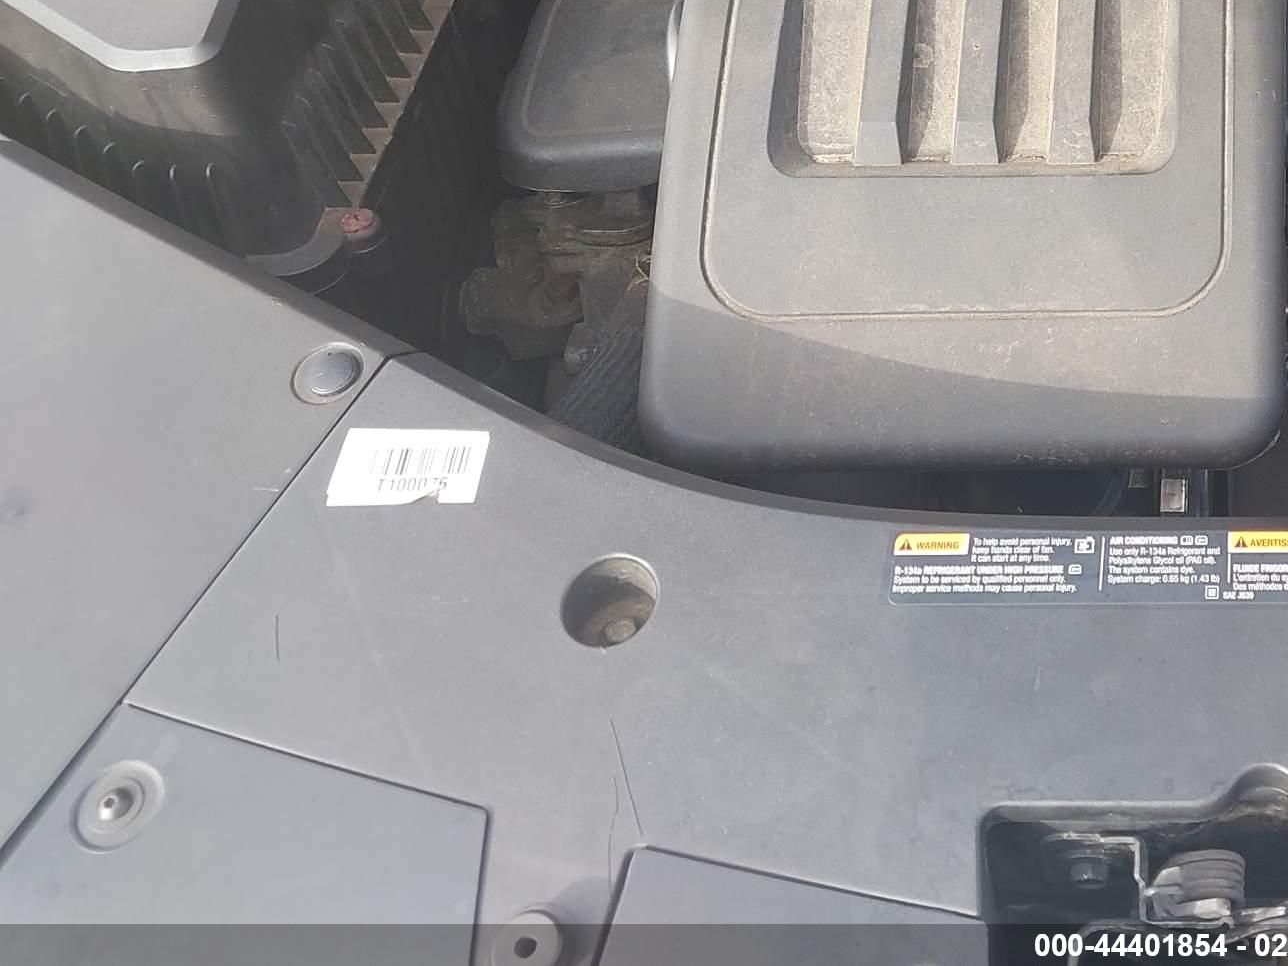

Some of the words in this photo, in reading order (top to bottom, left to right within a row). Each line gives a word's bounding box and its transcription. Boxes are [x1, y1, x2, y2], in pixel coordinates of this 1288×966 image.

[916, 541, 959, 549] WARNING
[974, 538, 981, 546] To
[983, 538, 998, 547] help
[999, 538, 1018, 546] avoid
[1020, 538, 1049, 547] personal
[1051, 538, 1072, 547] injury.
[1110, 547, 1122, 555] Use
[1124, 547, 1139, 556] only
[1140, 547, 1166, 555] R-134a
[1168, 547, 1205, 556] Refrigerant
[1207, 547, 1220, 555] and
[894, 575, 920, 585] System
[930, 575, 940, 583] be
[941, 575, 970, 583] serviced
[972, 575, 981, 585] by
[982, 575, 1012, 585] qualified
[1014, 575, 1048, 585] personnel
[1049, 575, 1065, 584] only.
[1108, 575, 1133, 584] System
[1180, 575, 1189, 584] kg
[893, 585, 924, 594] Improper
[926, 585, 951, 593] service
[985, 586, 1000, 594] may
[1024, 585, 1054, 594] personal
[1056, 585, 1077, 593] injury.
